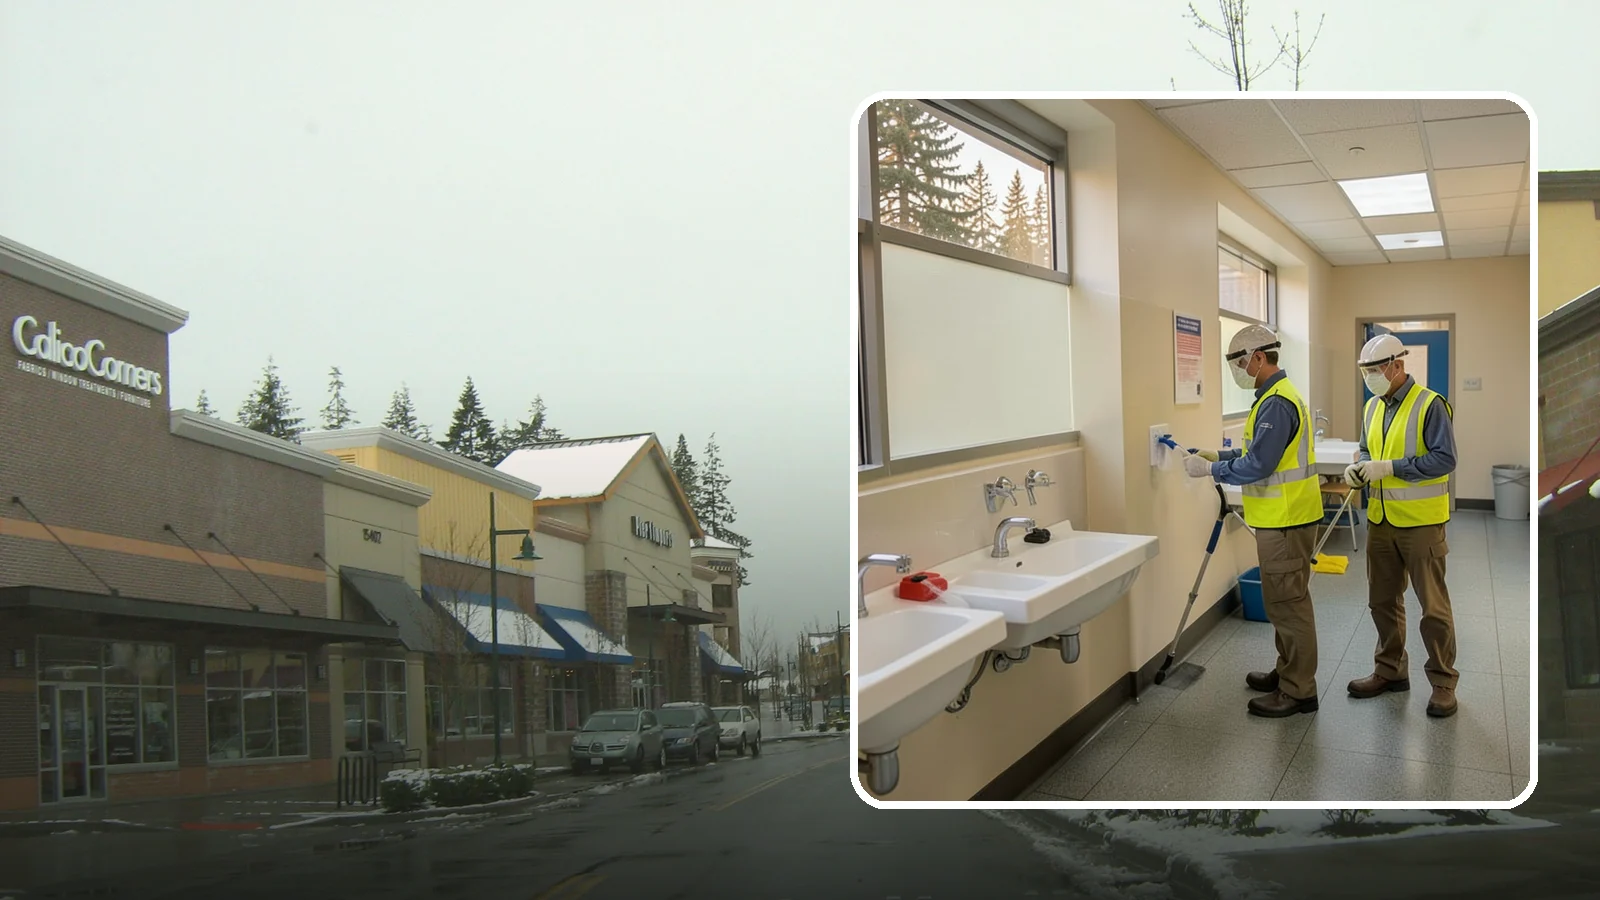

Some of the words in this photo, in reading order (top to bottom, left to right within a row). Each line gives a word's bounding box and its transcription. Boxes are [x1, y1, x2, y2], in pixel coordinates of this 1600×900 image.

[17, 360, 47, 377] FABRICS
[51, 370, 77, 386] WINDOW
[79, 379, 116, 398] TREATMENTS
[120, 391, 151, 408] FURNITURE
